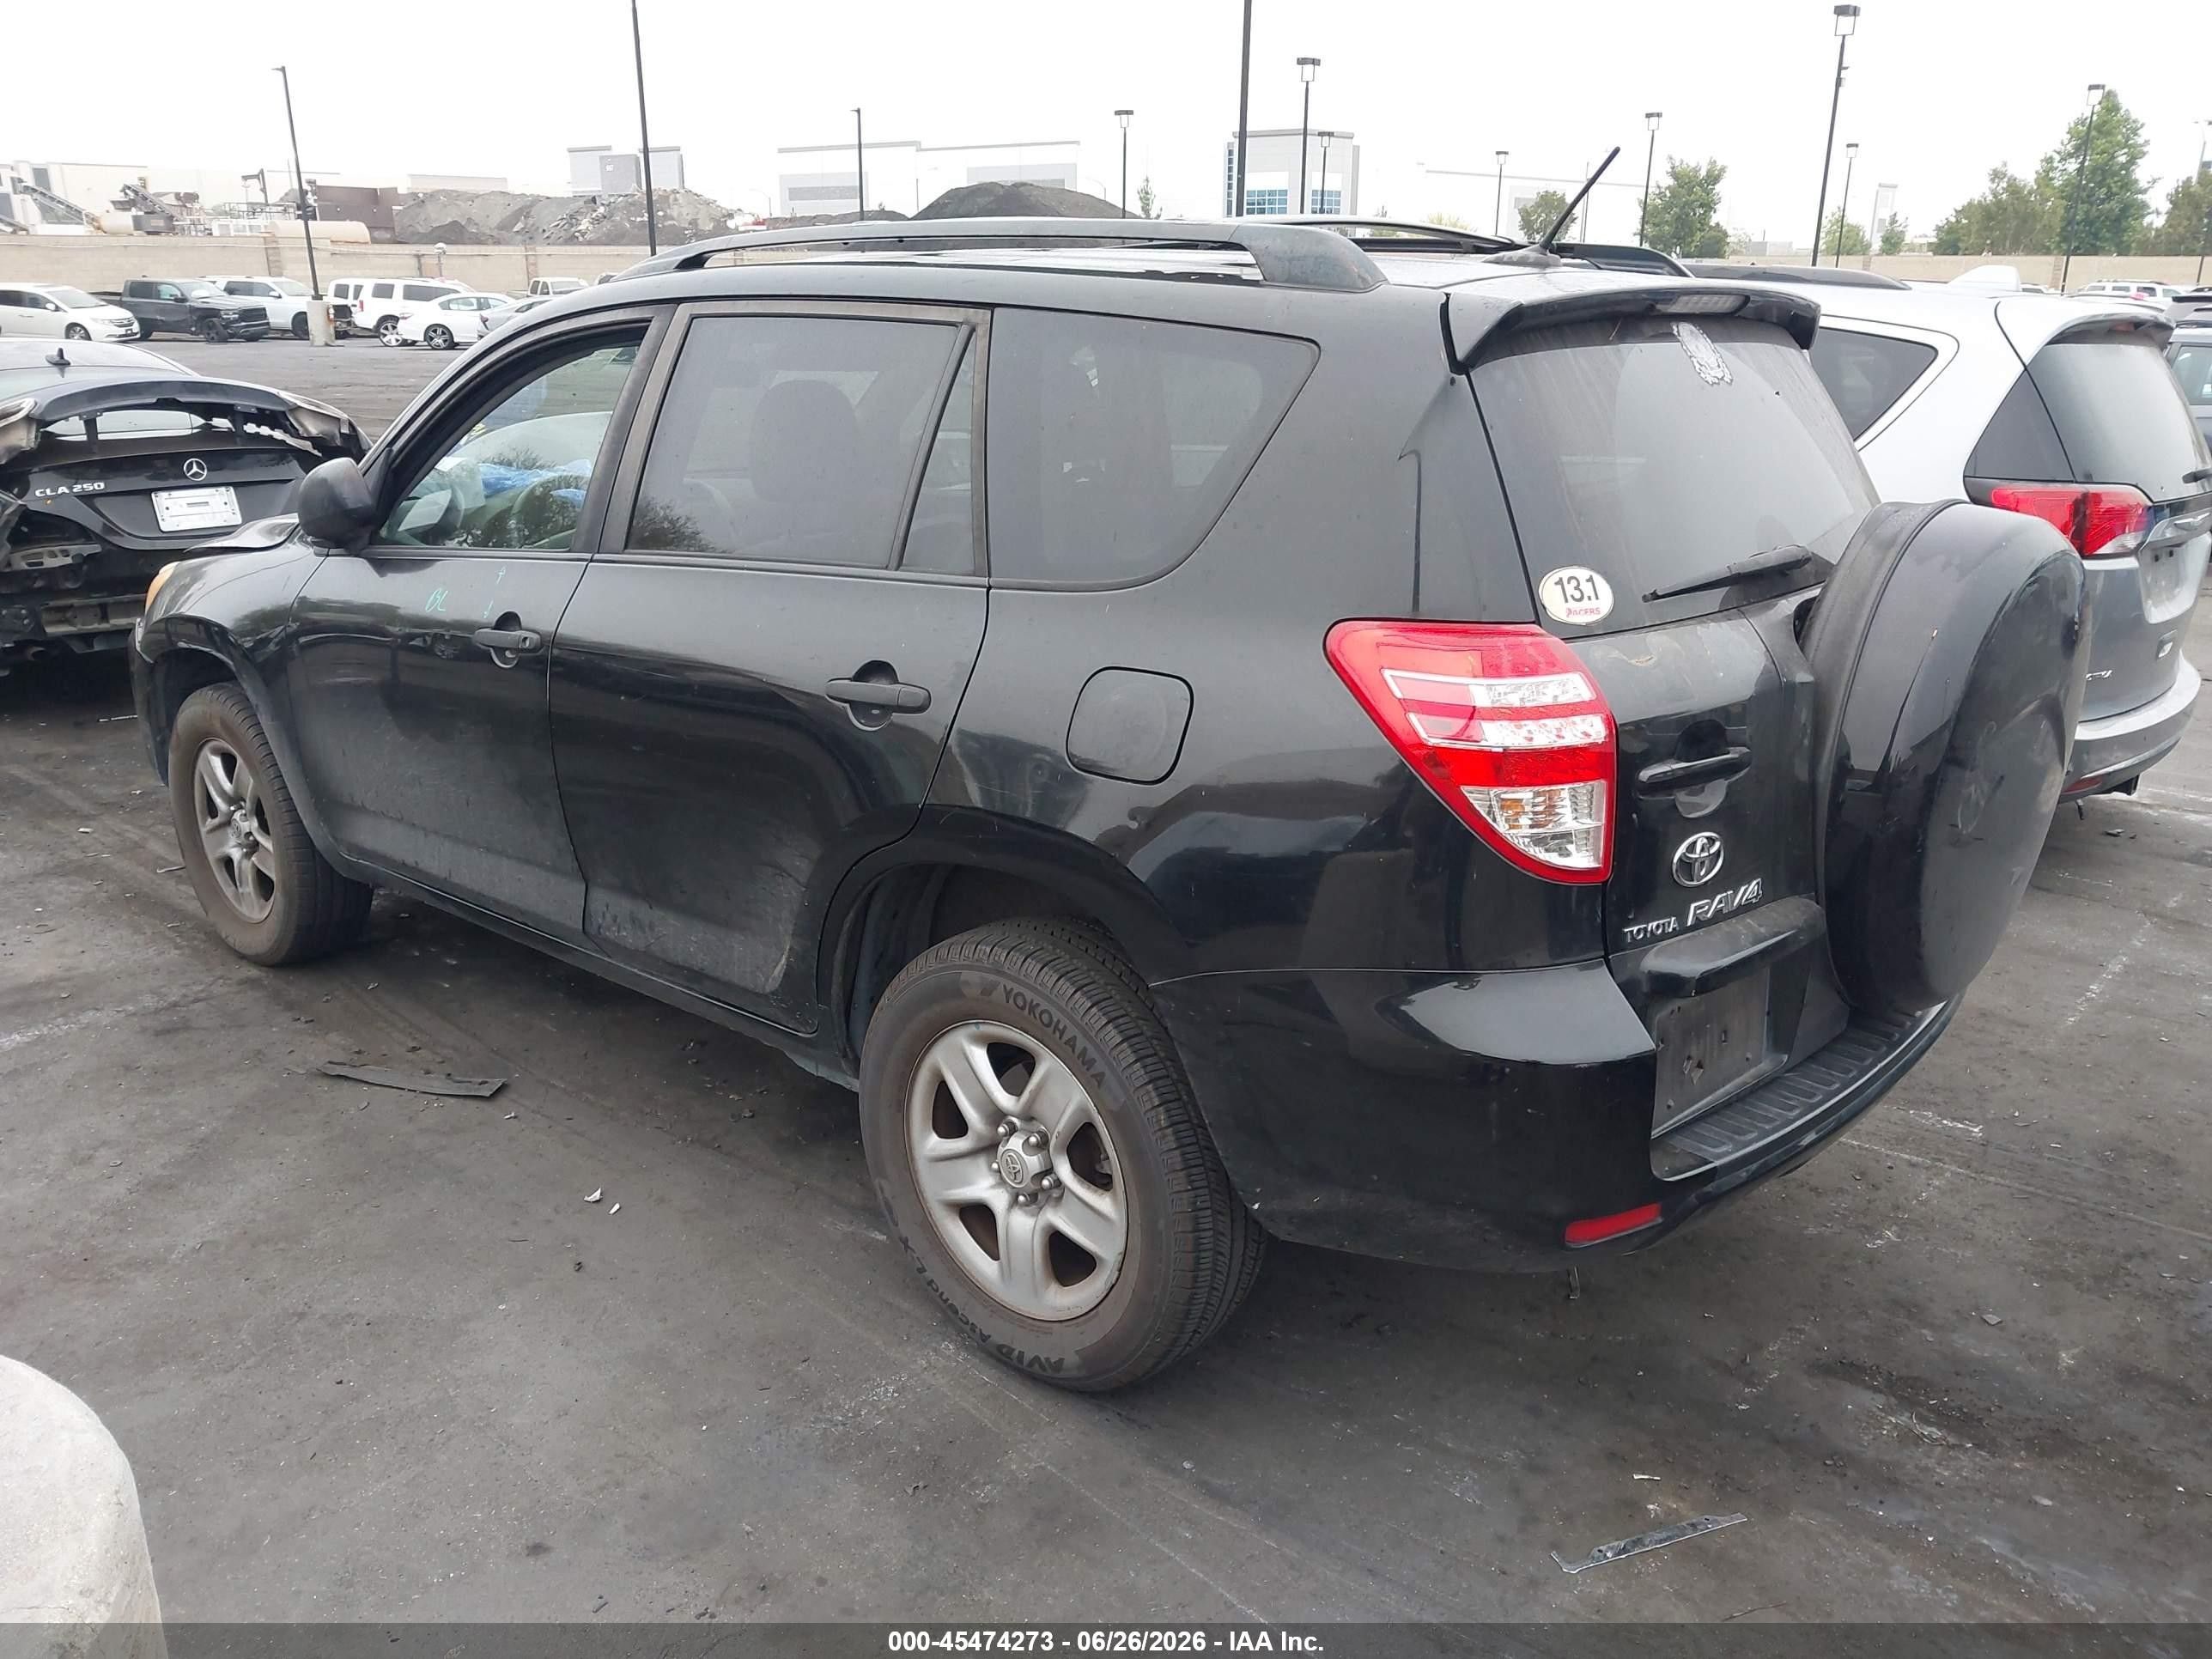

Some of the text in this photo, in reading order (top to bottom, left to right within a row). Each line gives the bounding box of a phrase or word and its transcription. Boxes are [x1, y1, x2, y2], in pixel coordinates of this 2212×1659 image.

[35, 482, 105, 497] CLA 250
[1554, 574, 1599, 603] 13.1
[1623, 878, 1763, 943] TOYOTA RAV4
[1002, 984, 1106, 1088] YOKOHAMA
[927, 1279, 992, 1343] Ascend
[996, 1343, 1066, 1373] AVID
